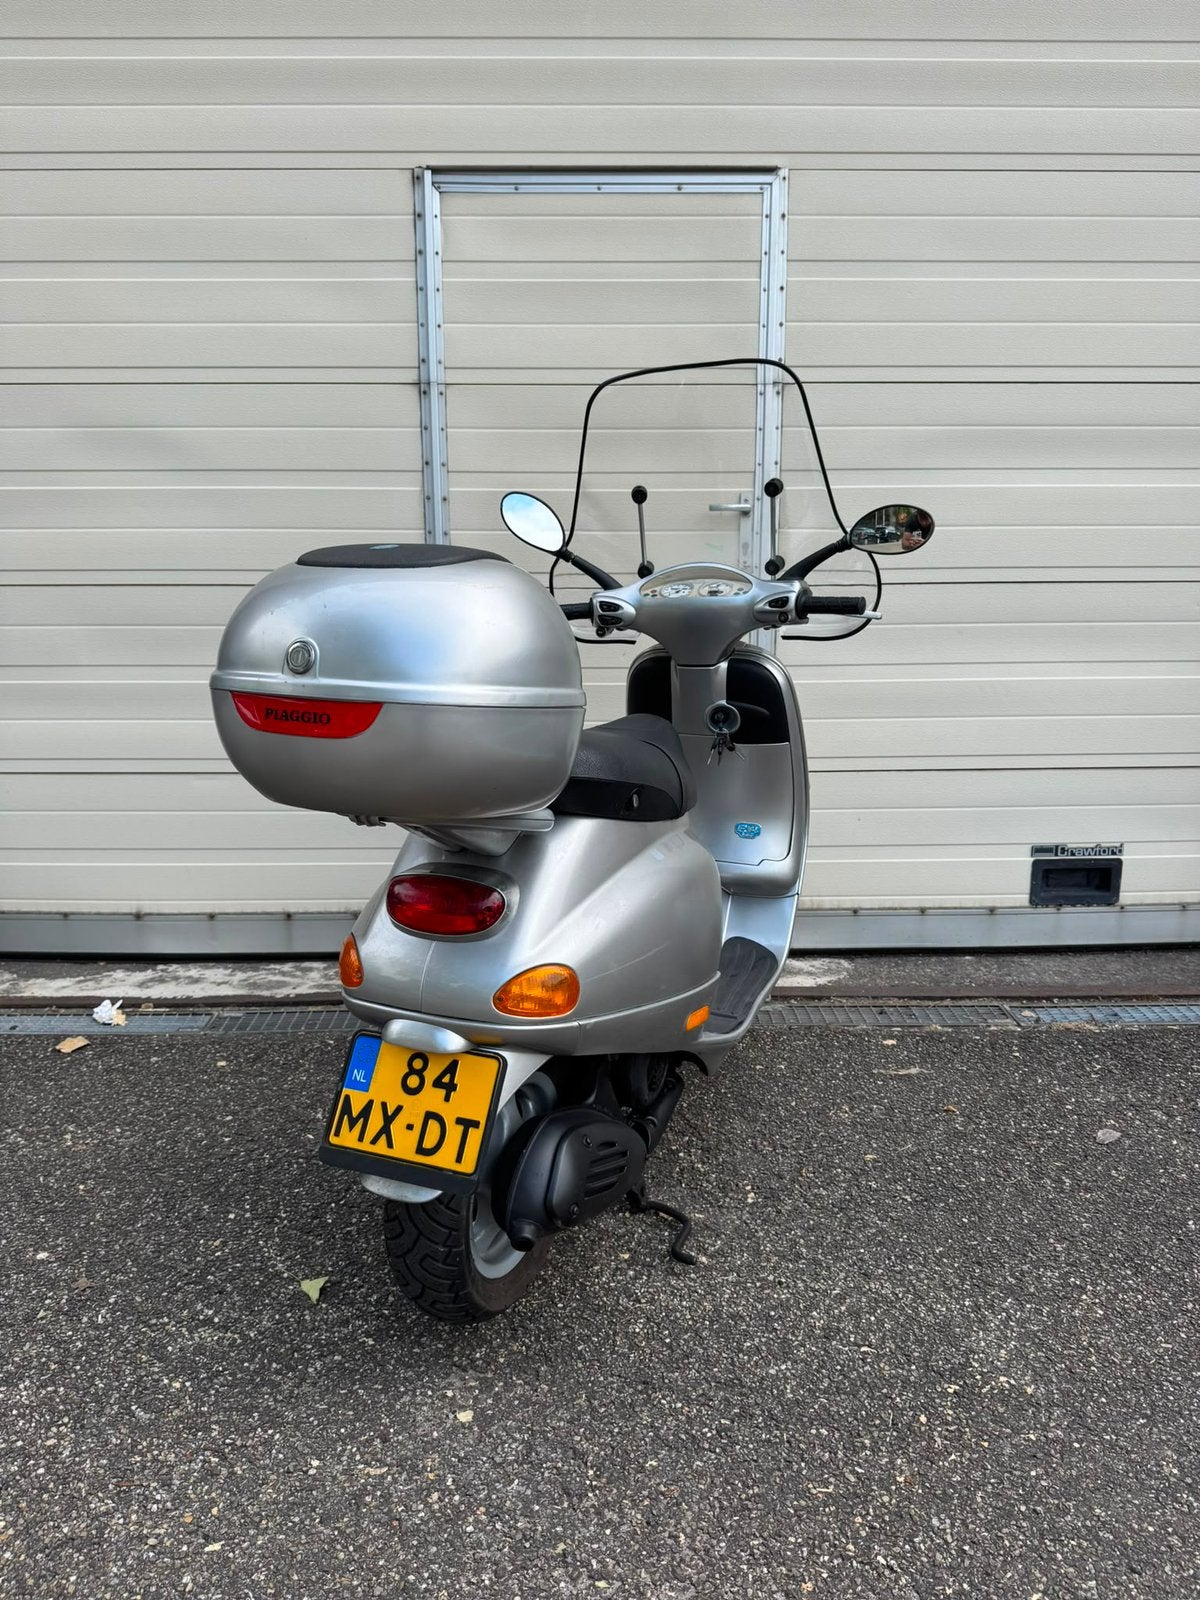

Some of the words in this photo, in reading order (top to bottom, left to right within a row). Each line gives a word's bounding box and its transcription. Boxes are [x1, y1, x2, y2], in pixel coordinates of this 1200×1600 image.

[265, 707, 331, 726] PIAGGIO
[1057, 843, 1124, 857] Crawford
[351, 1068, 367, 1083] NL
[400, 1051, 460, 1103] 84
[333, 1093, 481, 1164] MX-DT
